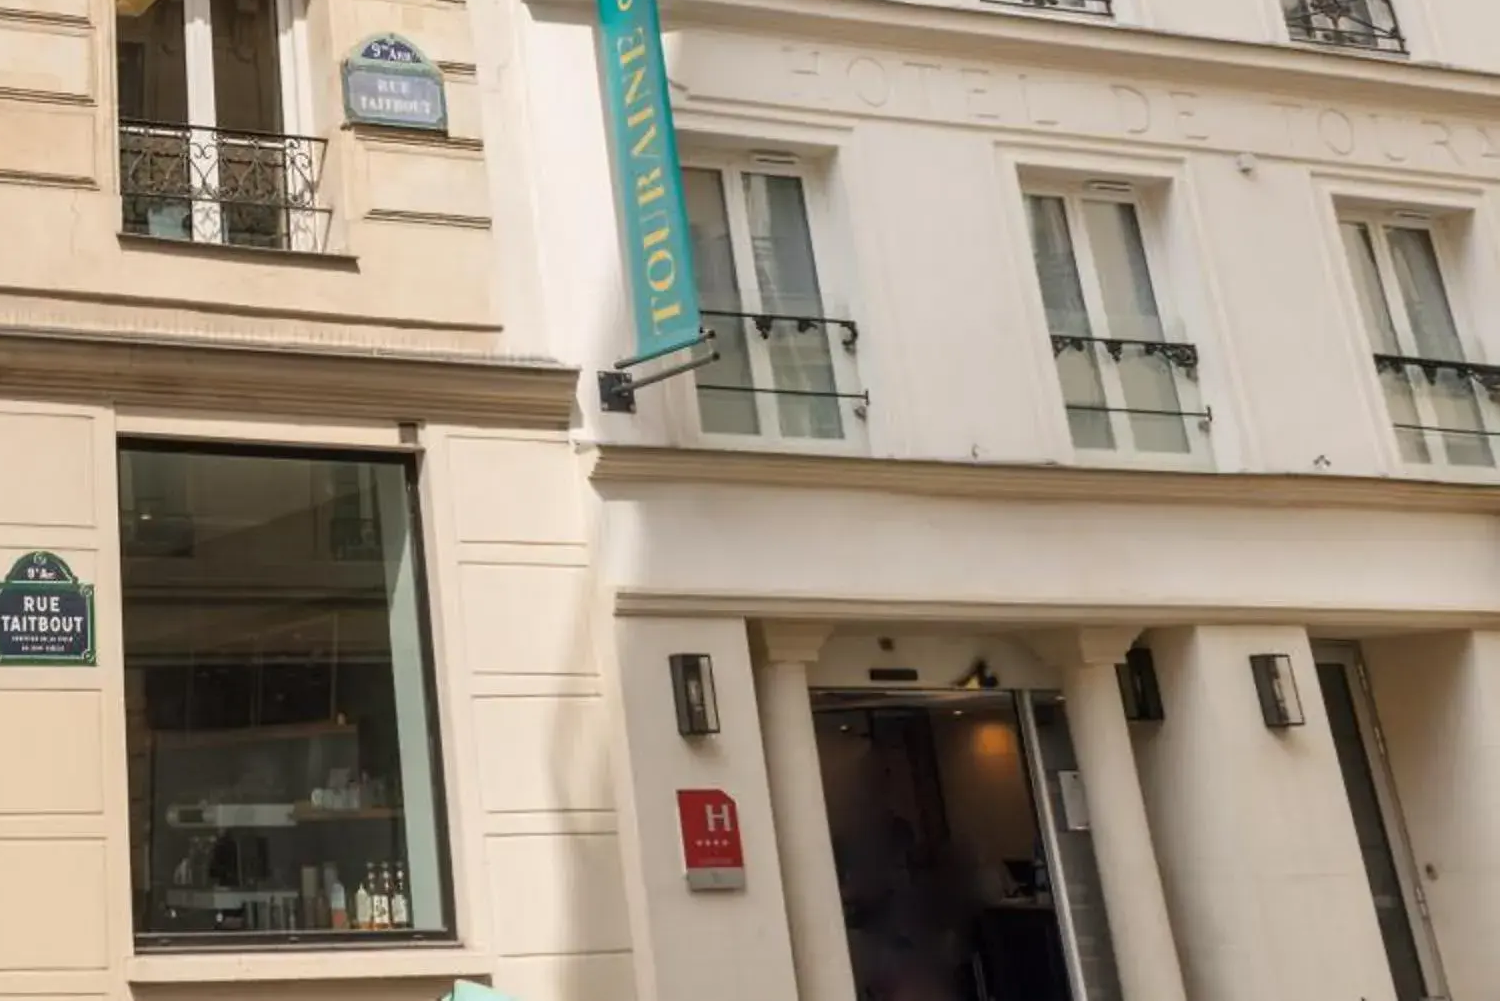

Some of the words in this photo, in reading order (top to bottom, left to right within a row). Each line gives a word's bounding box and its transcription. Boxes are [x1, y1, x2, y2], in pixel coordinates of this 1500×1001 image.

[617, 26, 681, 337] TOURAINE
[23, 596, 60, 612] RUE
[1, 615, 84, 632] TAITBOUT
[705, 803, 731, 831] H
